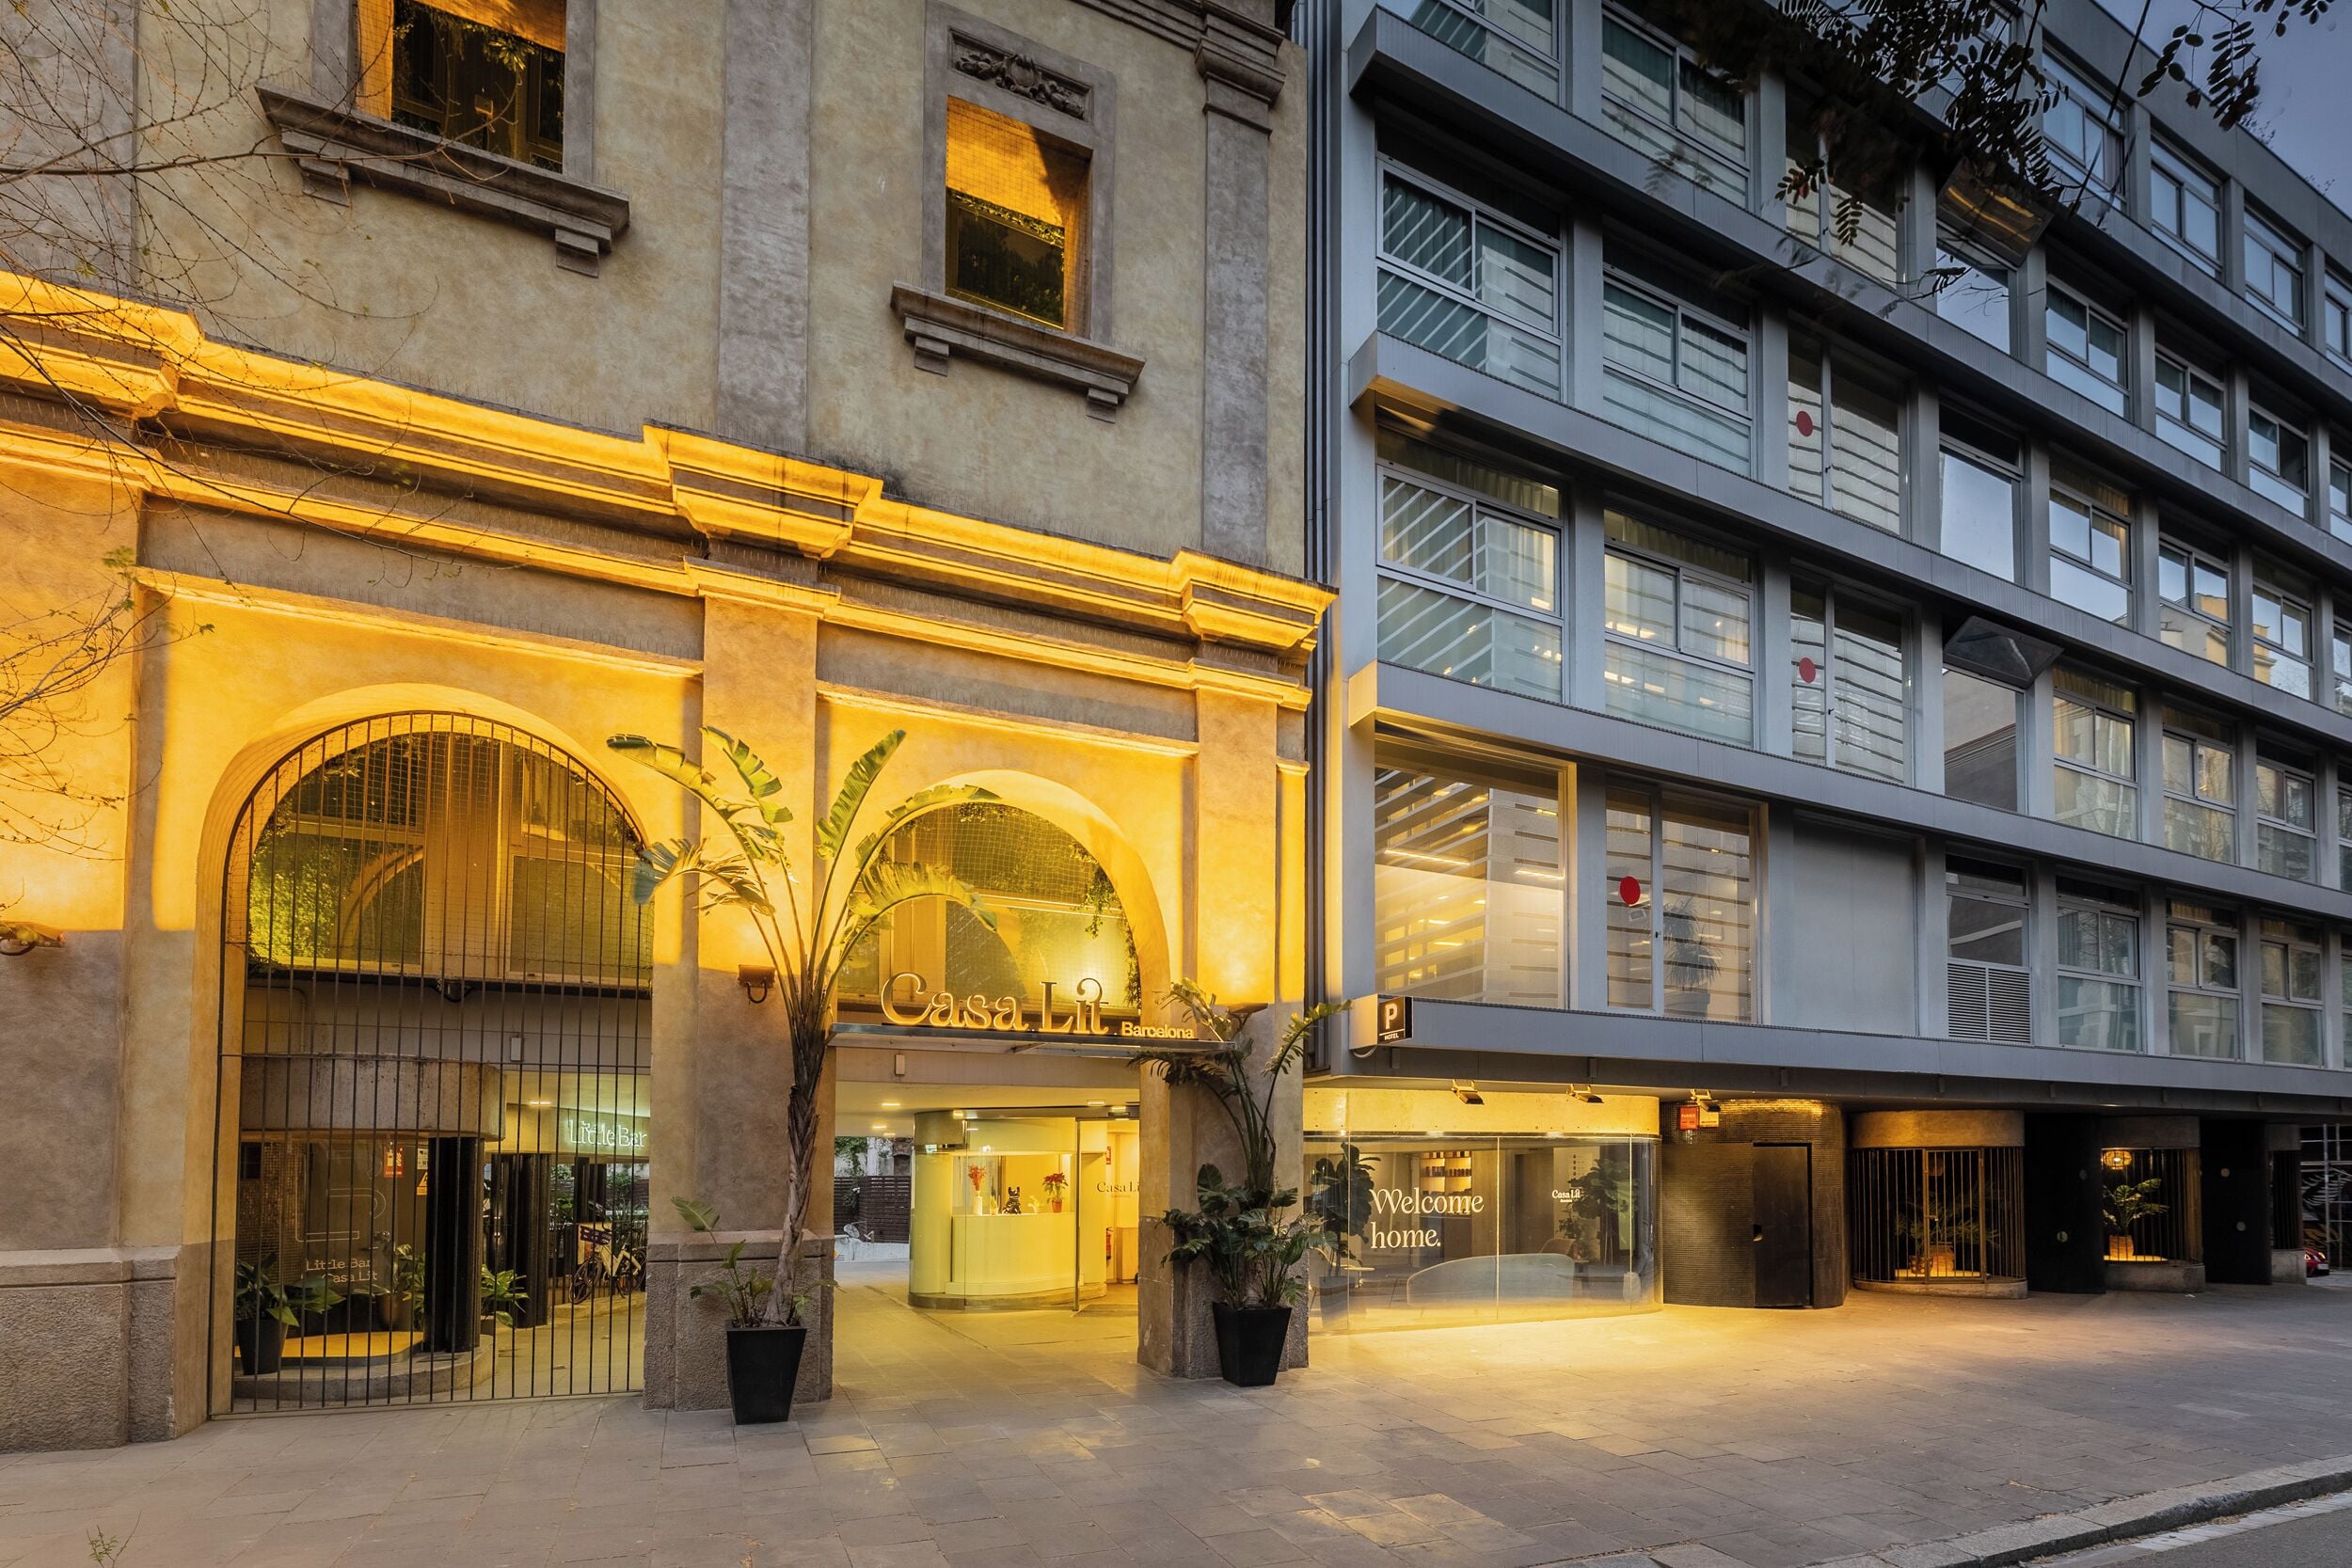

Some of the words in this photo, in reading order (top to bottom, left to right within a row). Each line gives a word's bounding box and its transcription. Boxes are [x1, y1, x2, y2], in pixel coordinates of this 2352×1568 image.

[881, 971, 1029, 1032] Casa
[1040, 977, 1110, 1036] Lit
[1120, 1021, 1196, 1039] Barcelona
[1385, 1003, 1398, 1030] P
[1384, 1032, 1399, 1041] HOTEL
[617, 1124, 648, 1148] Bar
[1096, 1180, 1126, 1193] Casa
[1129, 1180, 1140, 1193] Li
[1551, 1189, 1570, 1199] Casa
[1369, 1186, 1485, 1215] Welcome
[1370, 1221, 1442, 1249] home.
